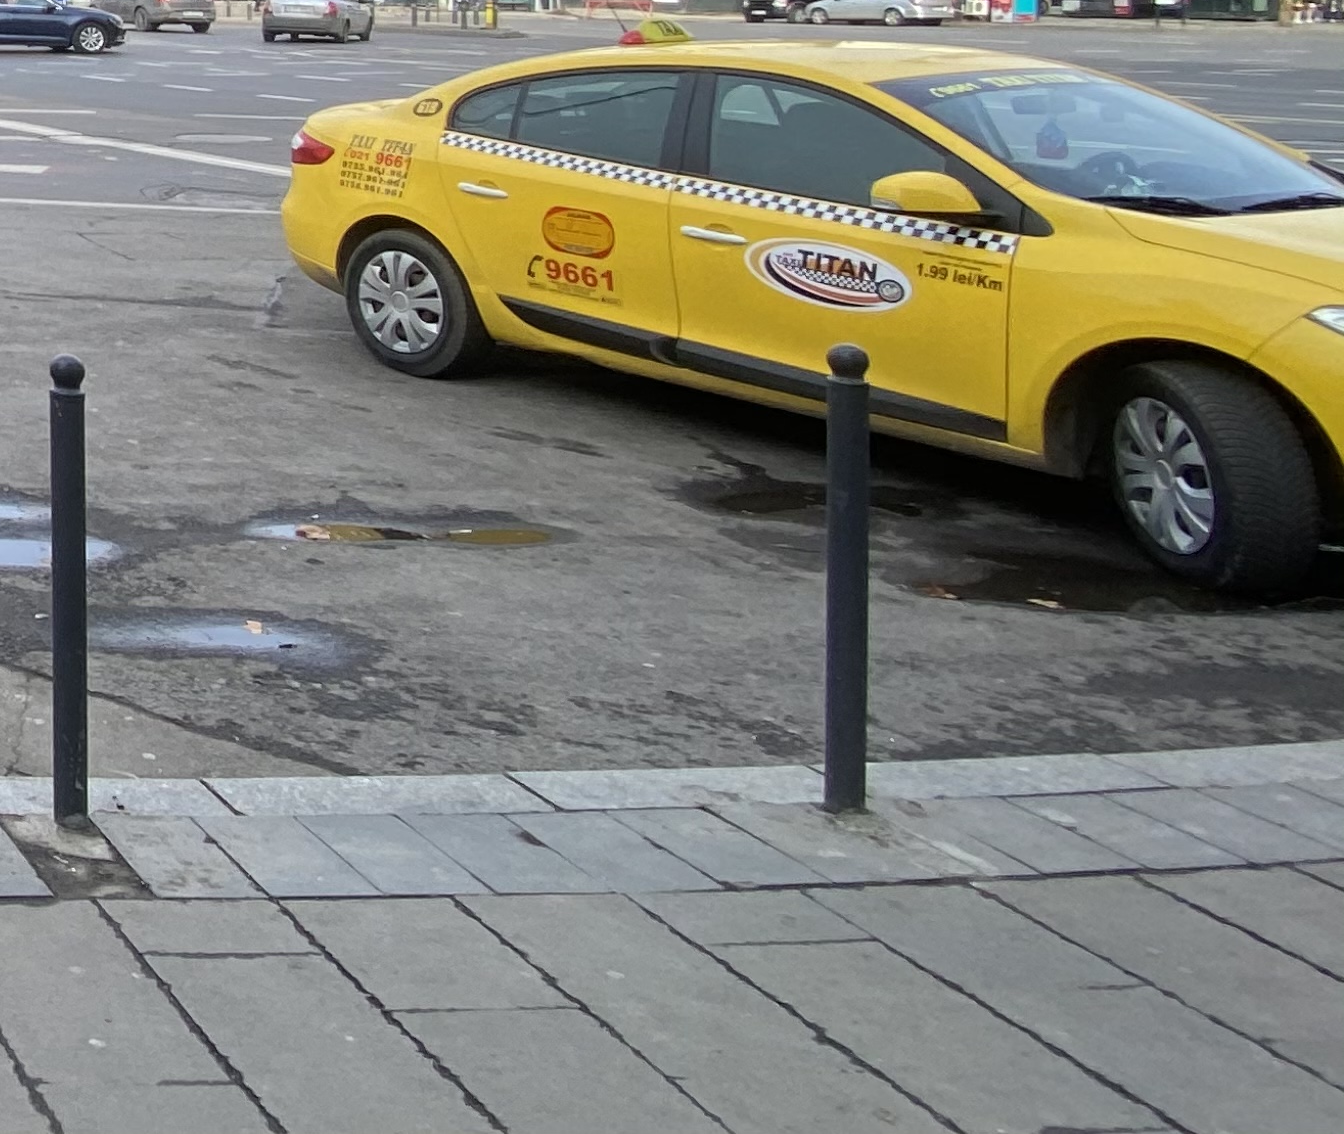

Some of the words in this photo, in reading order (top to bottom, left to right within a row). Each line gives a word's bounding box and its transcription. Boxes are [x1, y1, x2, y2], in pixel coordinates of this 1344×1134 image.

[350, 149, 370, 161] 021
[375, 152, 412, 172] 9661
[545, 258, 614, 292] 9661
[798, 249, 878, 282] TITAN
[917, 263, 948, 282] 1.99
[952, 268, 1004, 292] lei/Km
